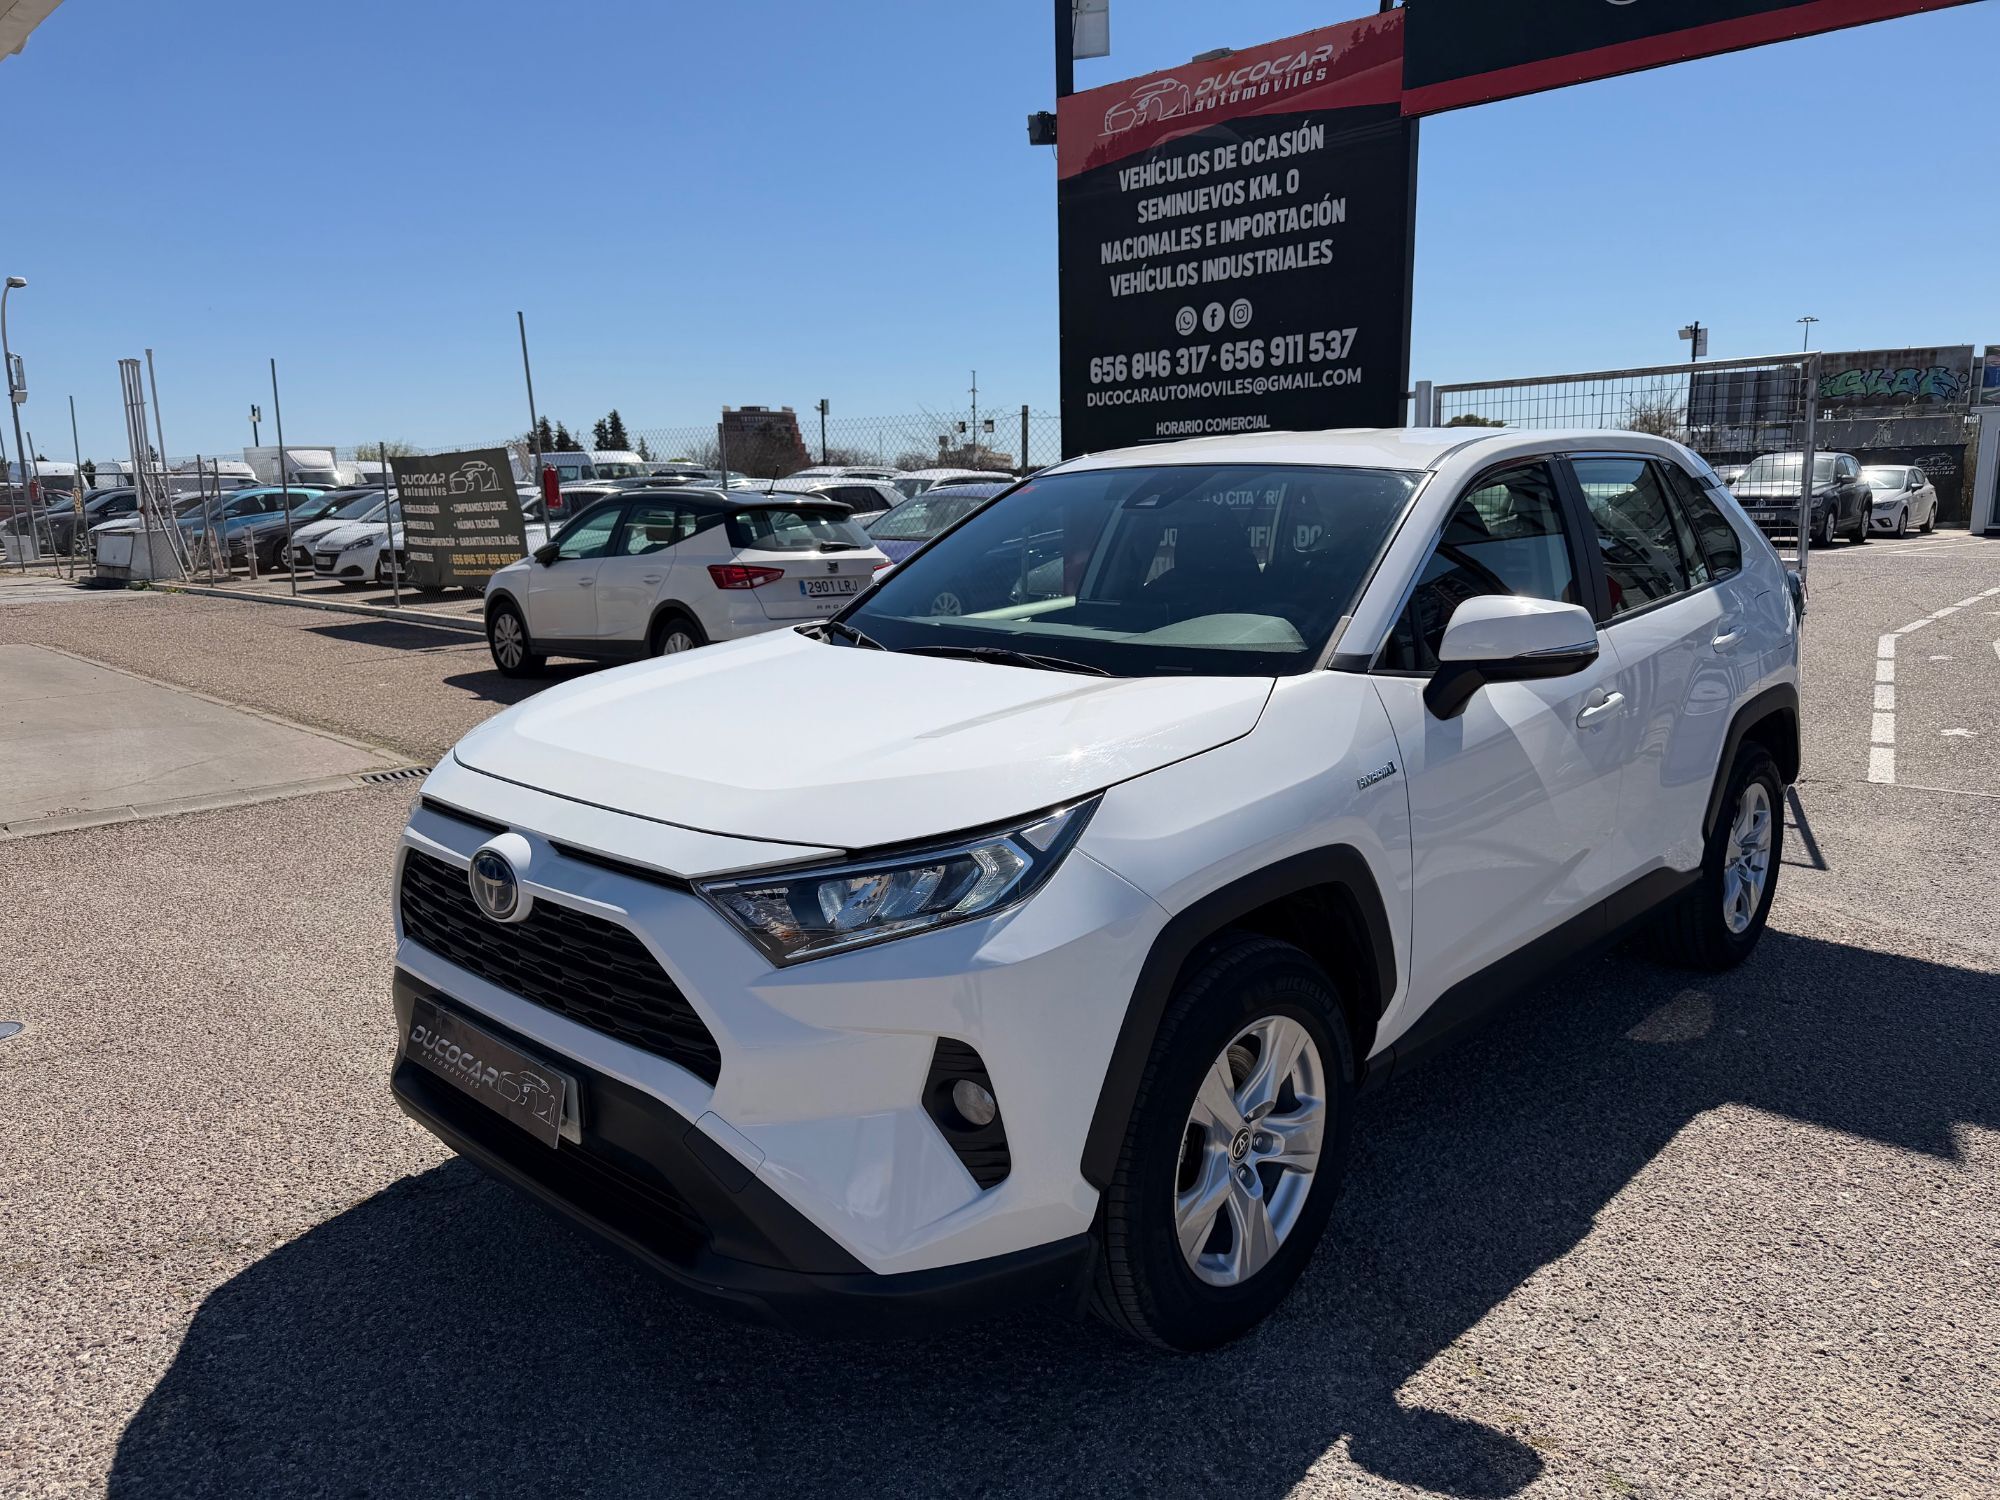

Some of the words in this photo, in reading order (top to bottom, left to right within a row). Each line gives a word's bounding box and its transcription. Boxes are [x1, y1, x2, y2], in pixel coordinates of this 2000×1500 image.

[1194, 44, 1333, 97] DUCOCAR
[1119, 151, 1210, 192] VEHÍCULOS
[1213, 144, 1237, 171] DE
[1241, 120, 1324, 166] OCASIÓN
[1137, 180, 1245, 224] SEMINUEVOS
[1249, 175, 1282, 201] KM.
[1101, 226, 1201, 265] NACIONALES
[1205, 222, 1217, 247] E
[1220, 193, 1346, 244] IMPORTACIÓN
[1110, 262, 1198, 297] VEHÍCULOS
[1202, 239, 1333, 283] INDUSTRIALES
[1089, 355, 1127, 384] 656
[1131, 349, 1170, 380] 846
[1270, 334, 1303, 364] 911
[1309, 328, 1358, 360] 537
[1087, 367, 1362, 407] DUCOCARAUTOMOVILES@GMAIL.COM
[1155, 420, 1203, 436] HORARIO
[1204, 414, 1271, 432] COMERCIAL
[401, 473, 446, 485] DUCOCAR
[807, 580, 835, 593] 2901
[839, 580, 858, 592] LRJ
[410, 1024, 499, 1088] DUCOCAR
